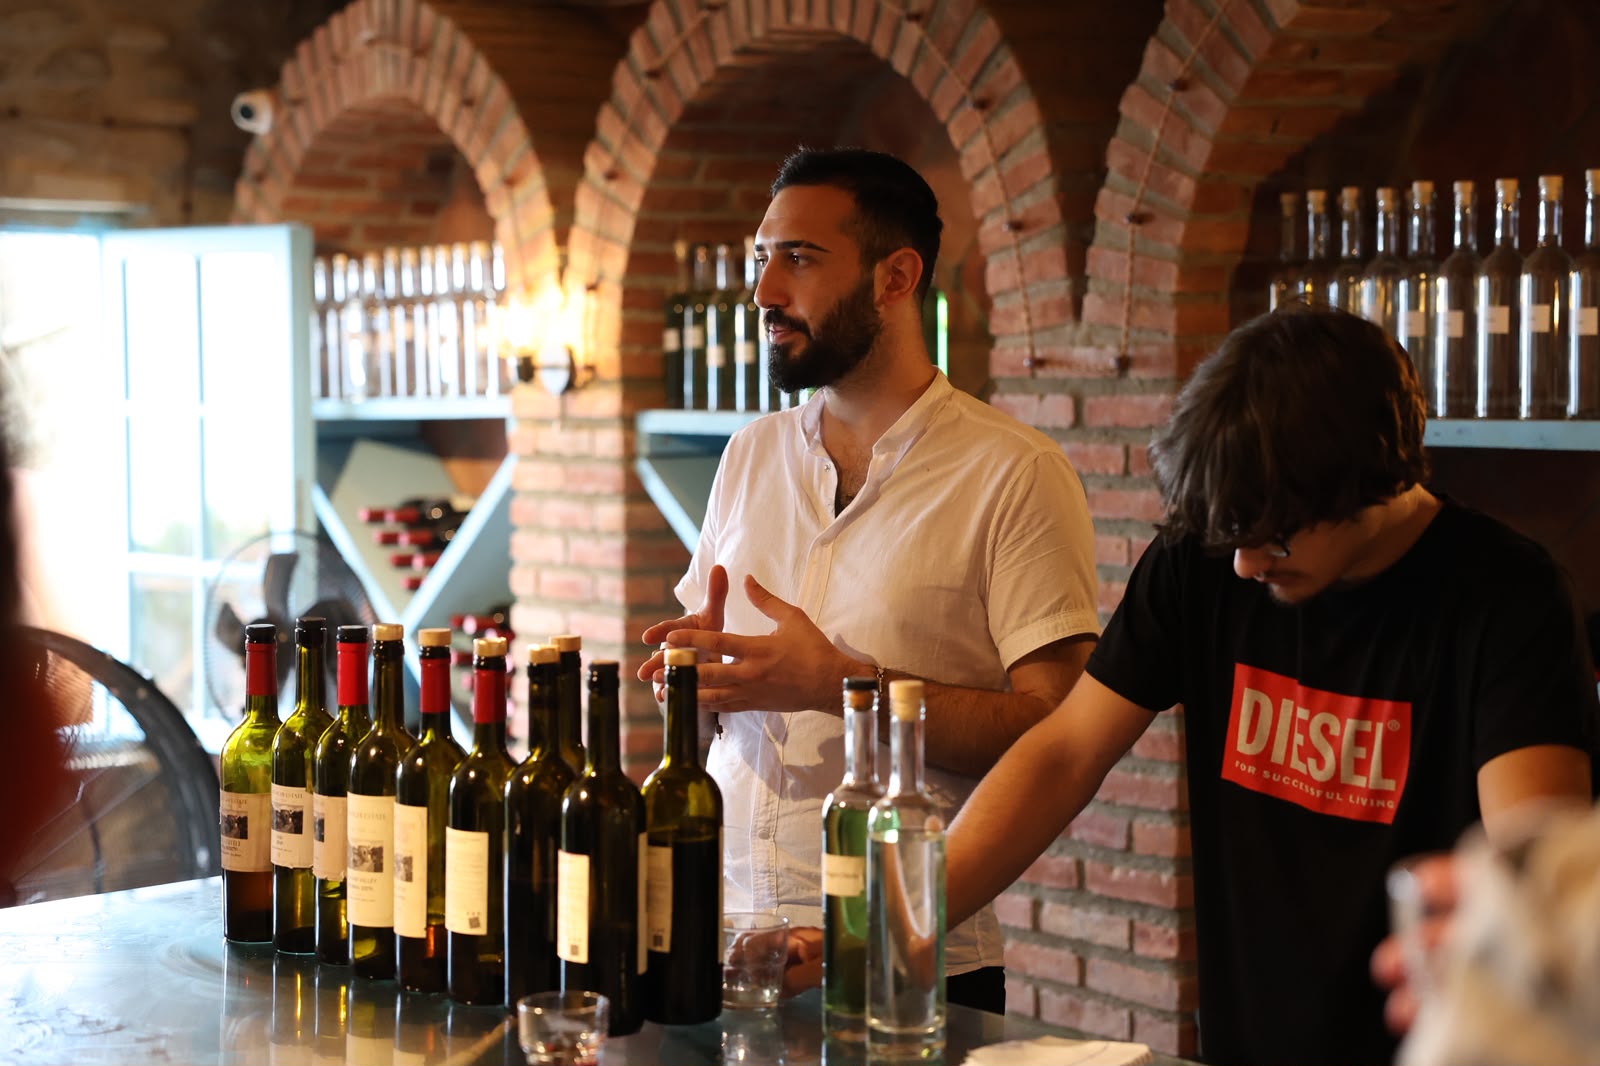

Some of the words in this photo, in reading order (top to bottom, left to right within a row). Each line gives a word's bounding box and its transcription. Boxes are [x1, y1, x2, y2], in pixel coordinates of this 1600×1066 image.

[1235, 760, 1257, 775] FOR
[1262, 770, 1343, 800] SUCCESSFUL
[1348, 794, 1395, 809] LIVING
